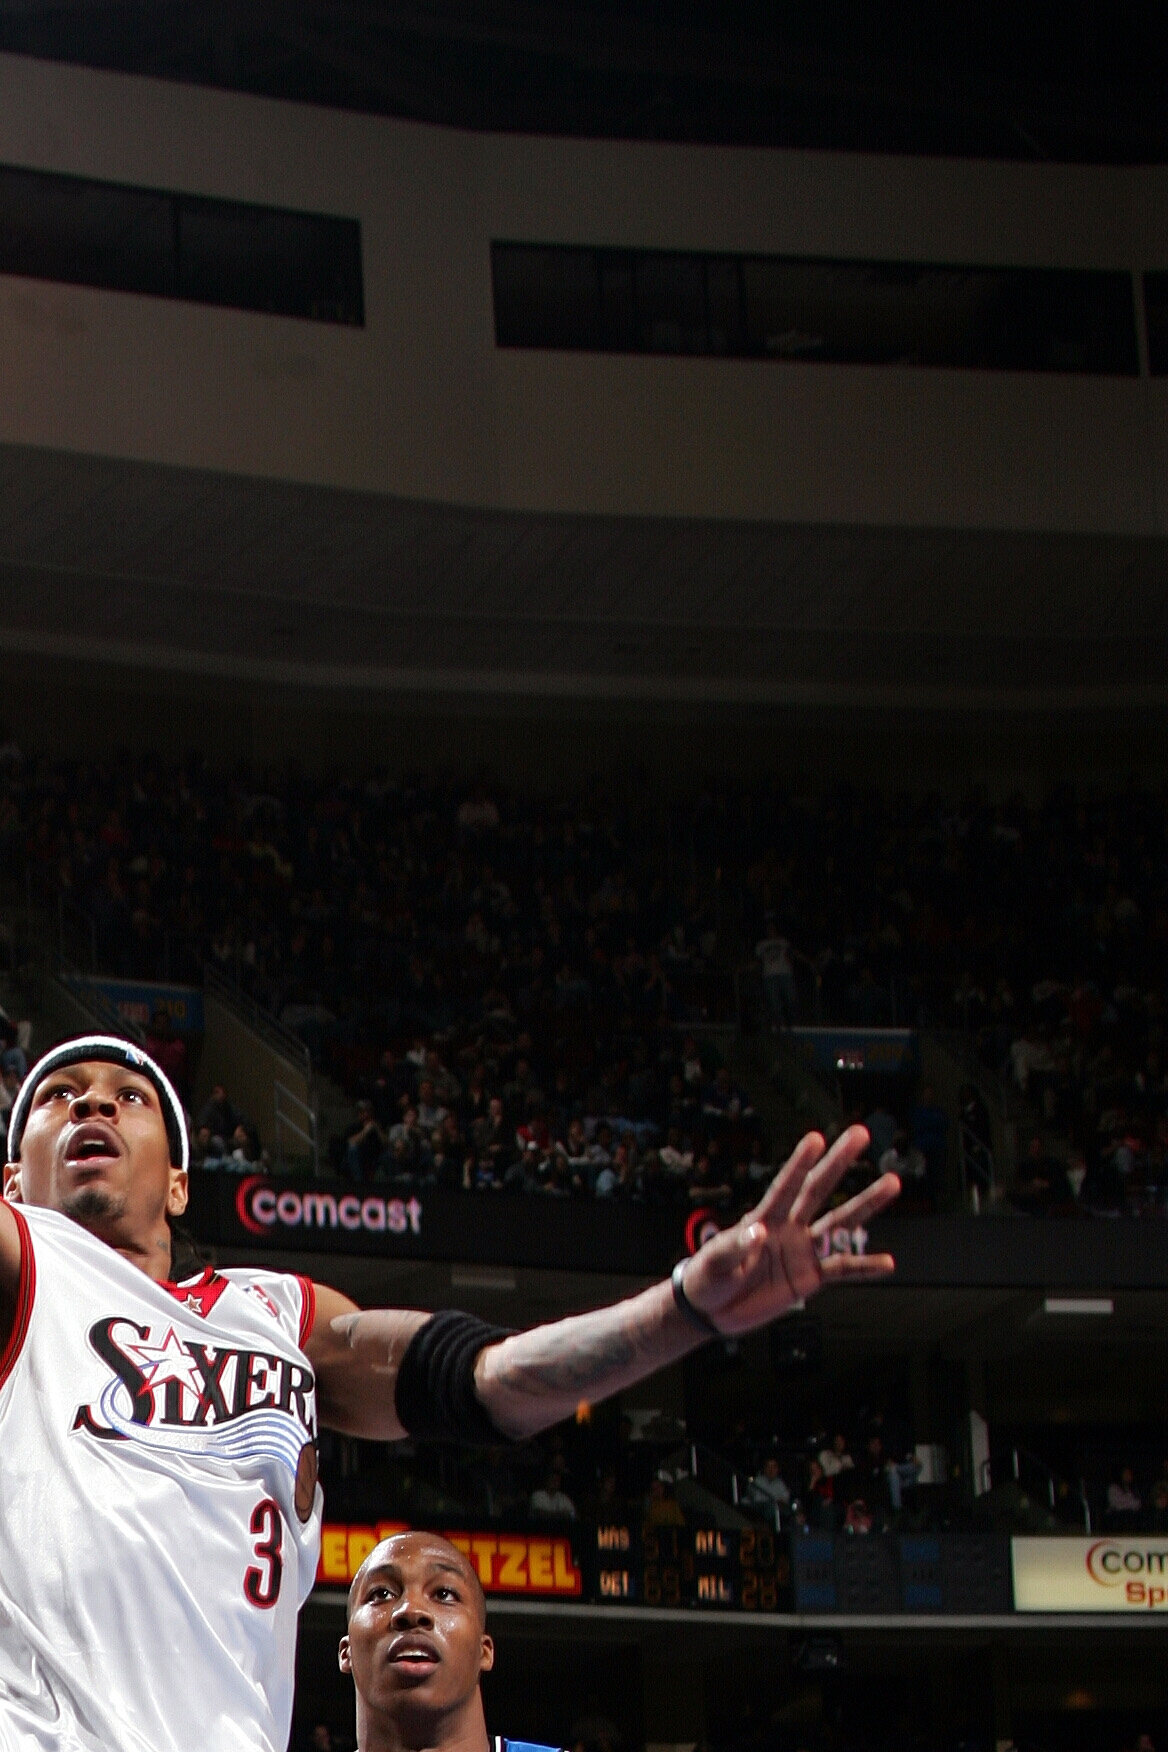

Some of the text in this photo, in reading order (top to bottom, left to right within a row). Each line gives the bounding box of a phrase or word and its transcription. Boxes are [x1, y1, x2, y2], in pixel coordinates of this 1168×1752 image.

[252, 1189, 423, 1235] comcast
[71, 1316, 316, 1441] SIXER
[243, 1498, 283, 1609] 3
[1126, 1582, 1168, 1608] Sp
